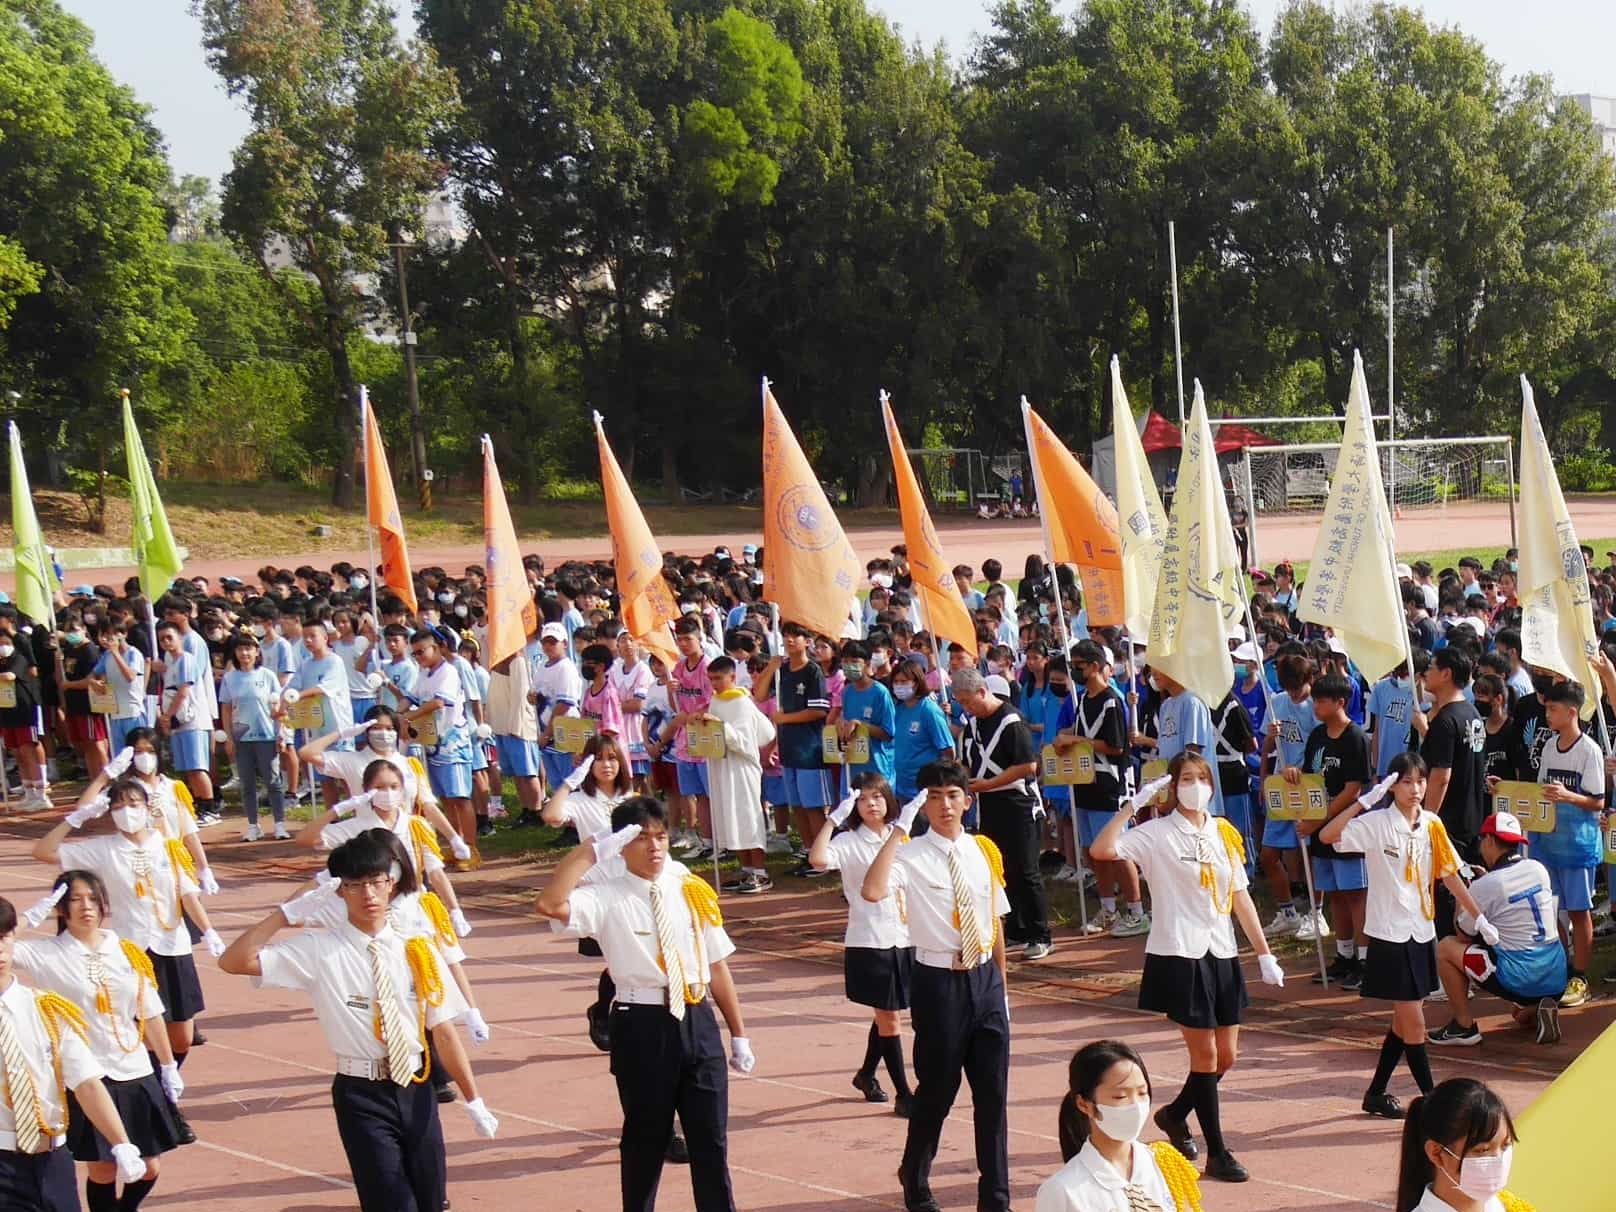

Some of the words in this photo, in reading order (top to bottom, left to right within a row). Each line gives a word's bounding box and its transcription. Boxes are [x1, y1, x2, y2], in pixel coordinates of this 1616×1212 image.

[1268, 788, 1325, 810] 國二丙
[1497, 797, 1551, 821] 國二丁
